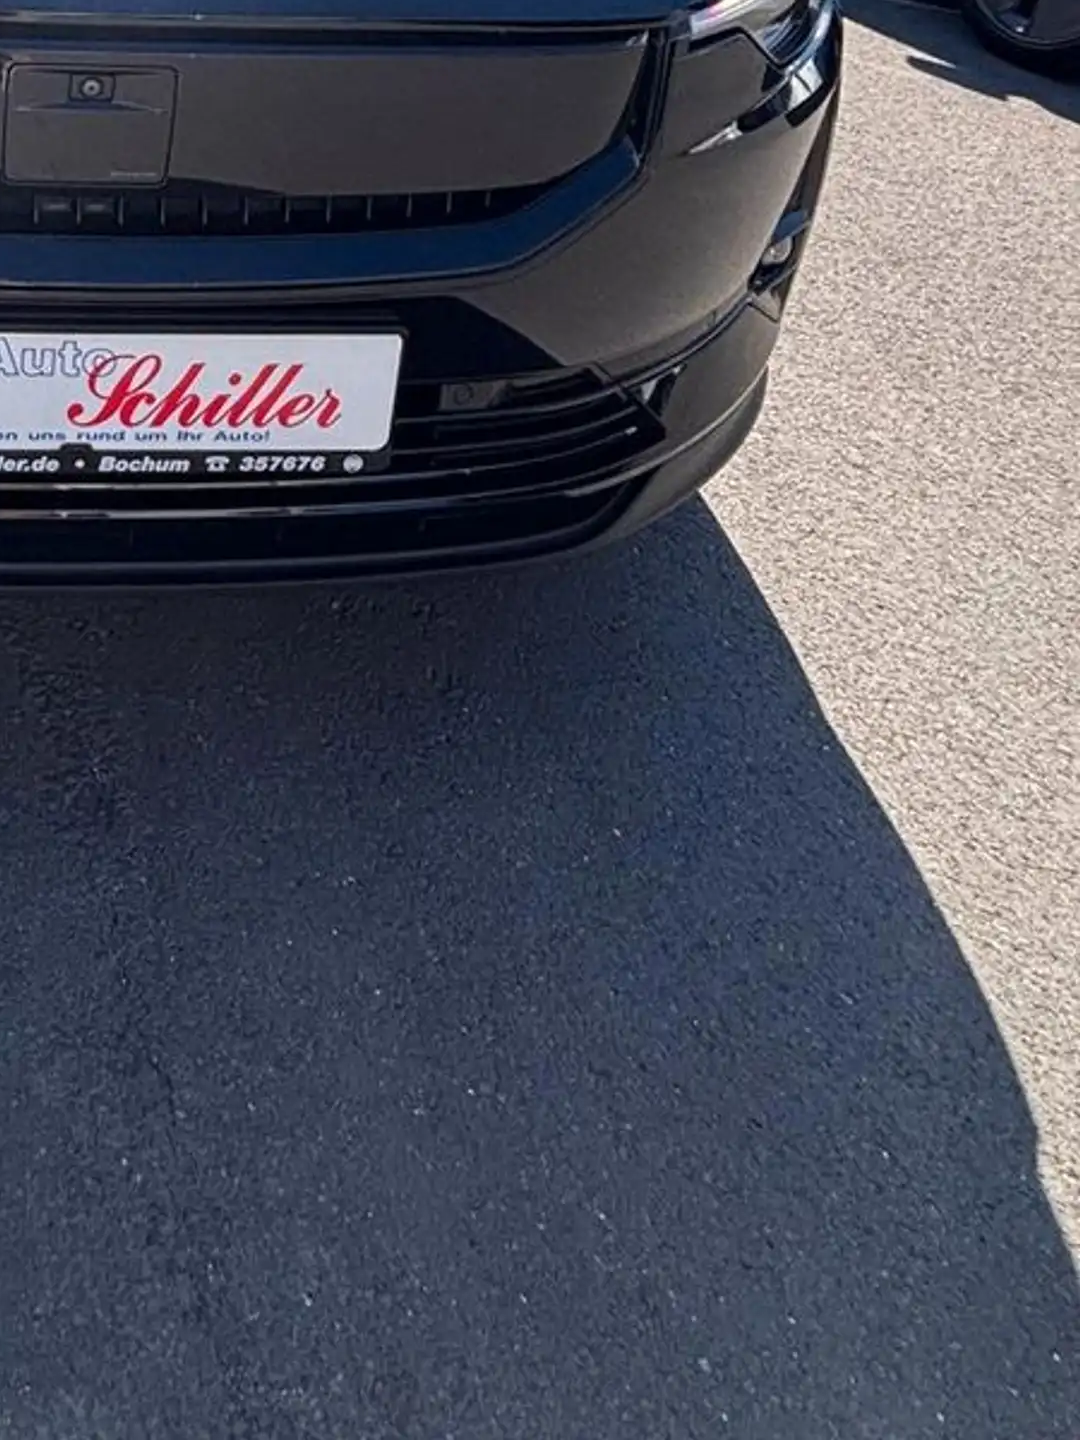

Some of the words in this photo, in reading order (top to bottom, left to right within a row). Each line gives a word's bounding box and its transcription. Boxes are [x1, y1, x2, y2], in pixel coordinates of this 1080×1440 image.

[66, 354, 342, 429] Schiller
[28, 431, 67, 441] uns
[76, 429, 126, 442] rund
[134, 432, 168, 442] um
[176, 430, 204, 442] Ihr
[213, 430, 270, 443] Auto!
[98, 455, 191, 473] Bochum
[238, 455, 326, 473] 357676
